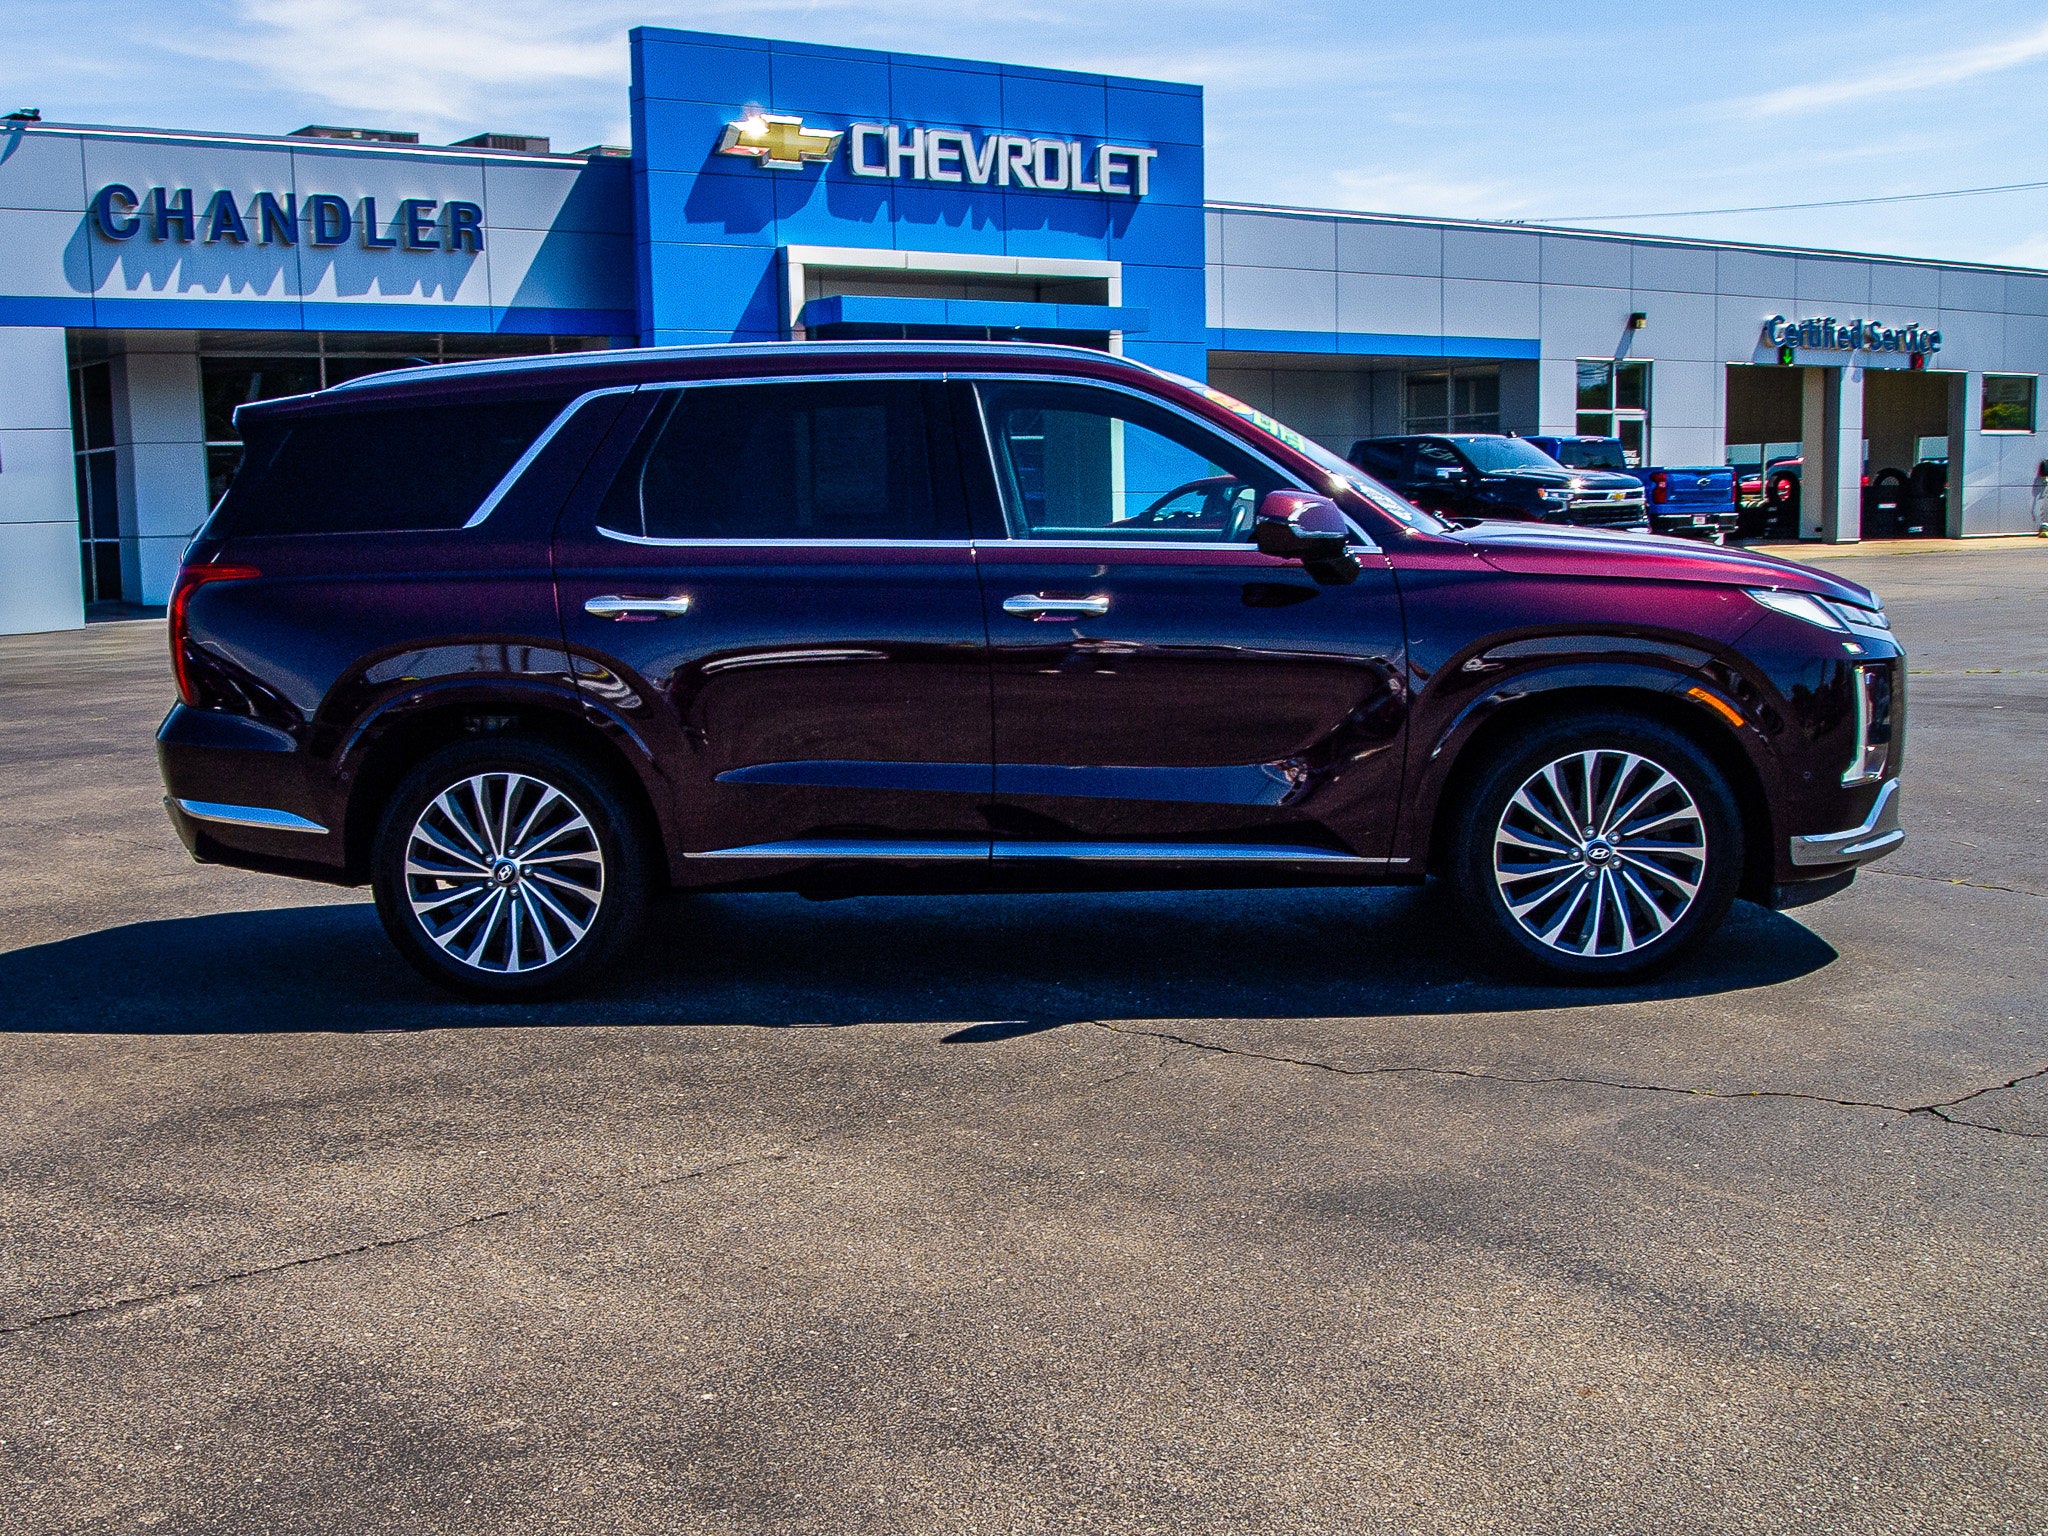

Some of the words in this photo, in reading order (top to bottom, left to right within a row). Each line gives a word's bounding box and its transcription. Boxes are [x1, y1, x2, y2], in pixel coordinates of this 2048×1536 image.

[850, 123, 1158, 195] CHEVROLET
[97, 182, 484, 252] CHANDLER
[1765, 314, 1864, 349] Certified
[1867, 320, 1943, 353] Service
